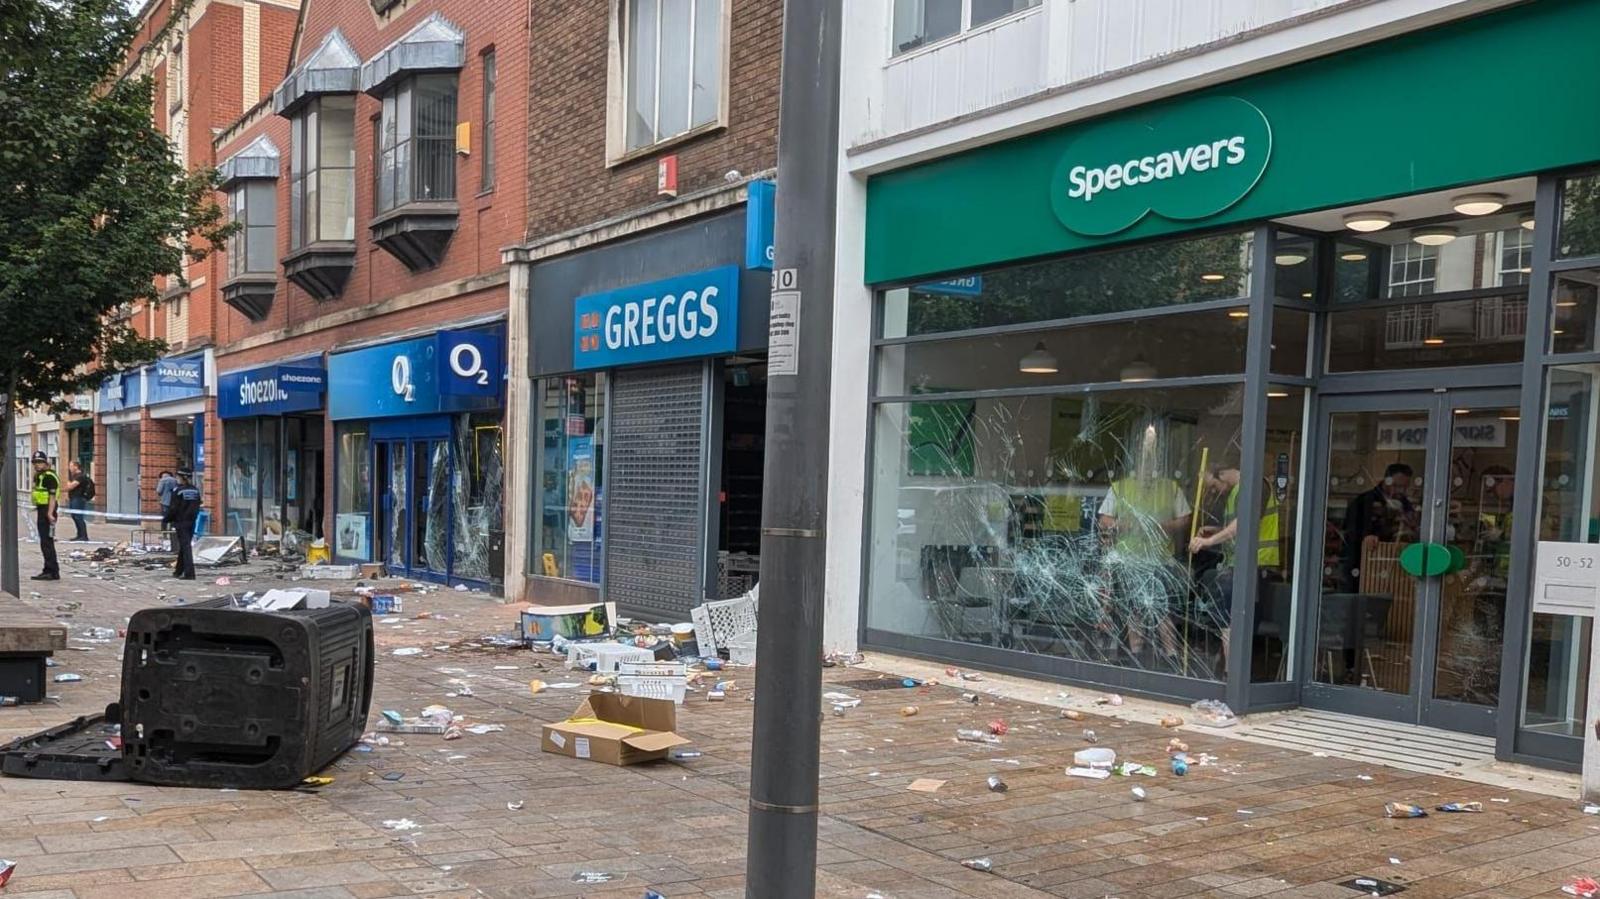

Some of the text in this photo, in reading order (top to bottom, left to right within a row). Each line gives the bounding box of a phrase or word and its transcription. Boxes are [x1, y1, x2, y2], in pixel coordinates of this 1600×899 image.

[1068, 136, 1245, 201] Specsavers
[604, 286, 719, 350] GREGGS
[158, 368, 199, 379] HALIFAX
[281, 373, 322, 384] shoezone
